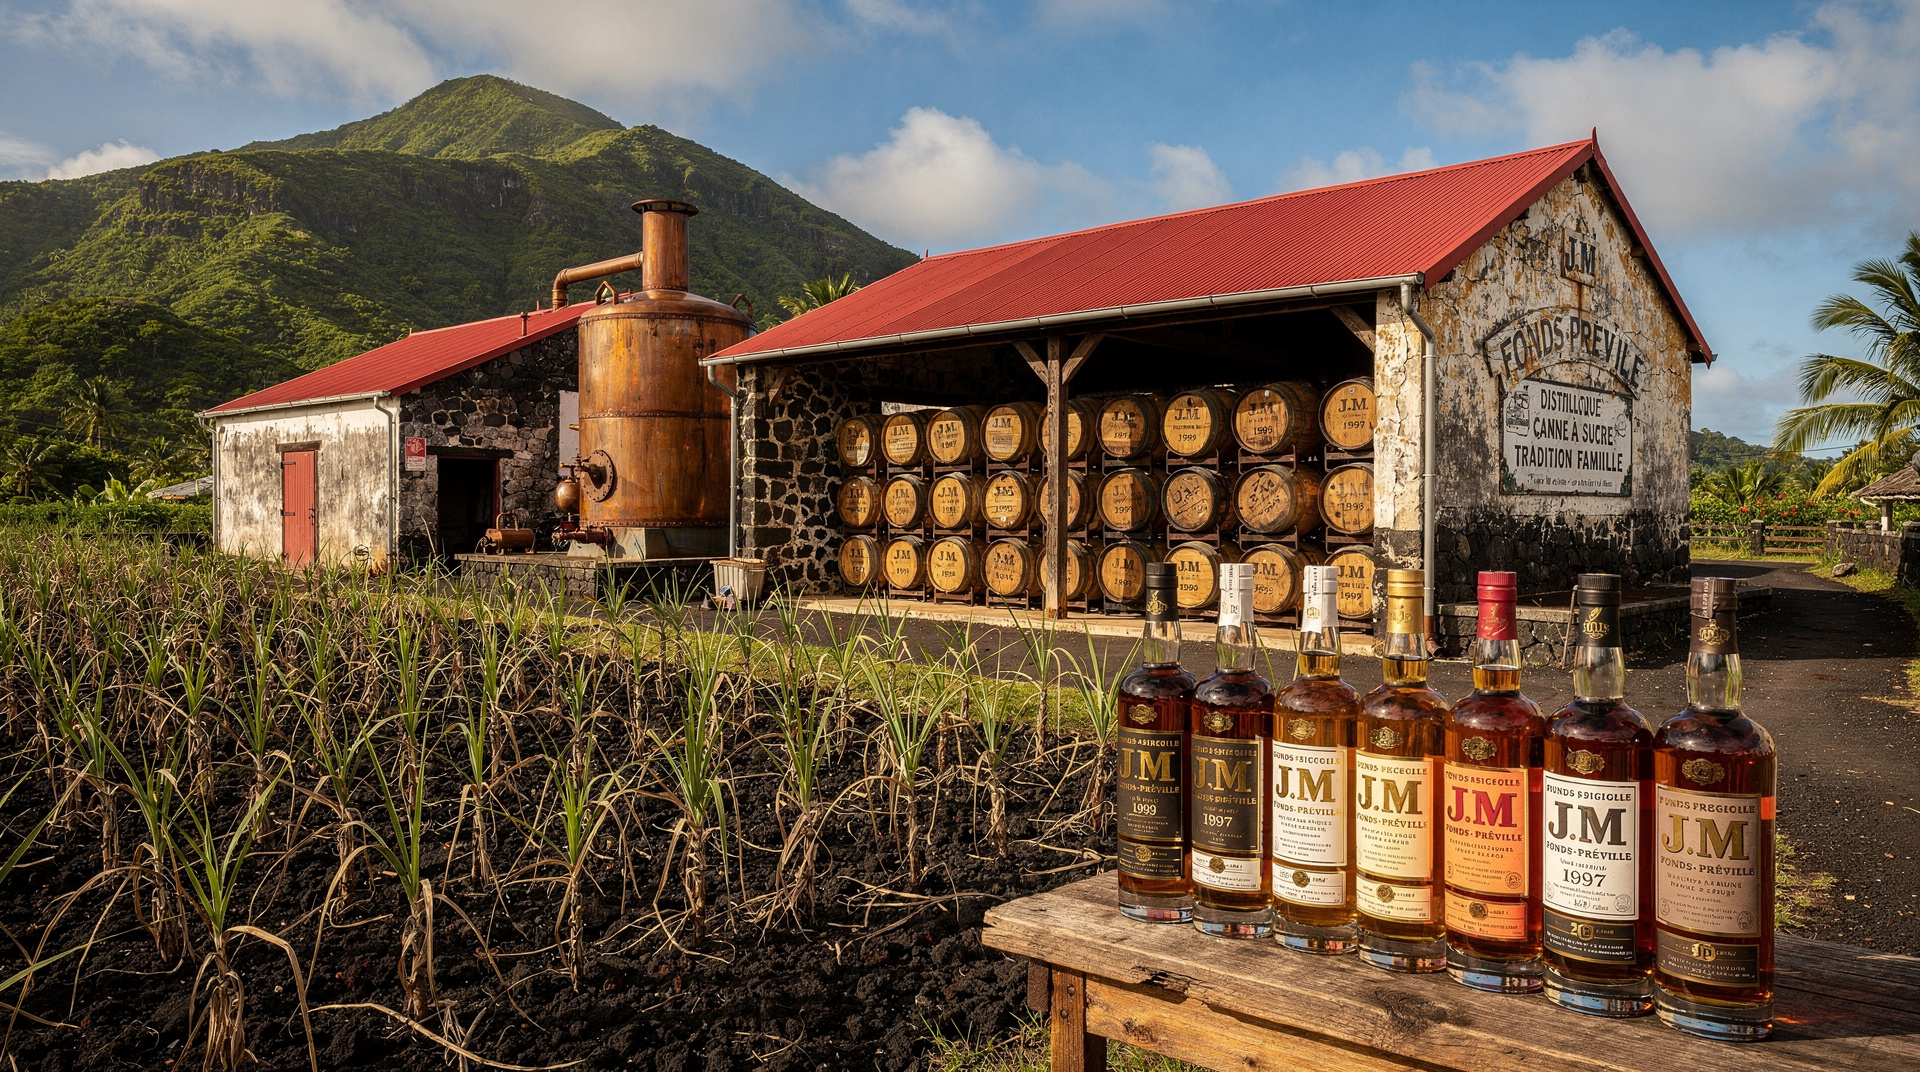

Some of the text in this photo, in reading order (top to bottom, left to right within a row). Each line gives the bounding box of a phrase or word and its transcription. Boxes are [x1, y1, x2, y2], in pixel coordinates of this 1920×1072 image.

[1501, 316, 1565, 380] FONDS
[1571, 417, 1579, 442] À
[1582, 423, 1613, 446] SUCRE
[1119, 748, 1175, 782] J.M
[1193, 756, 1252, 793] J.M
[1276, 764, 1336, 803] J.M
[1132, 802, 1157, 816] 1999
[1358, 774, 1423, 815] J.M
[1447, 785, 1518, 828] J.M
[1202, 813, 1233, 828] 1997
[1548, 800, 1627, 846] J.M
[1661, 812, 1749, 861] J.M
[1562, 868, 1607, 888] 1997
